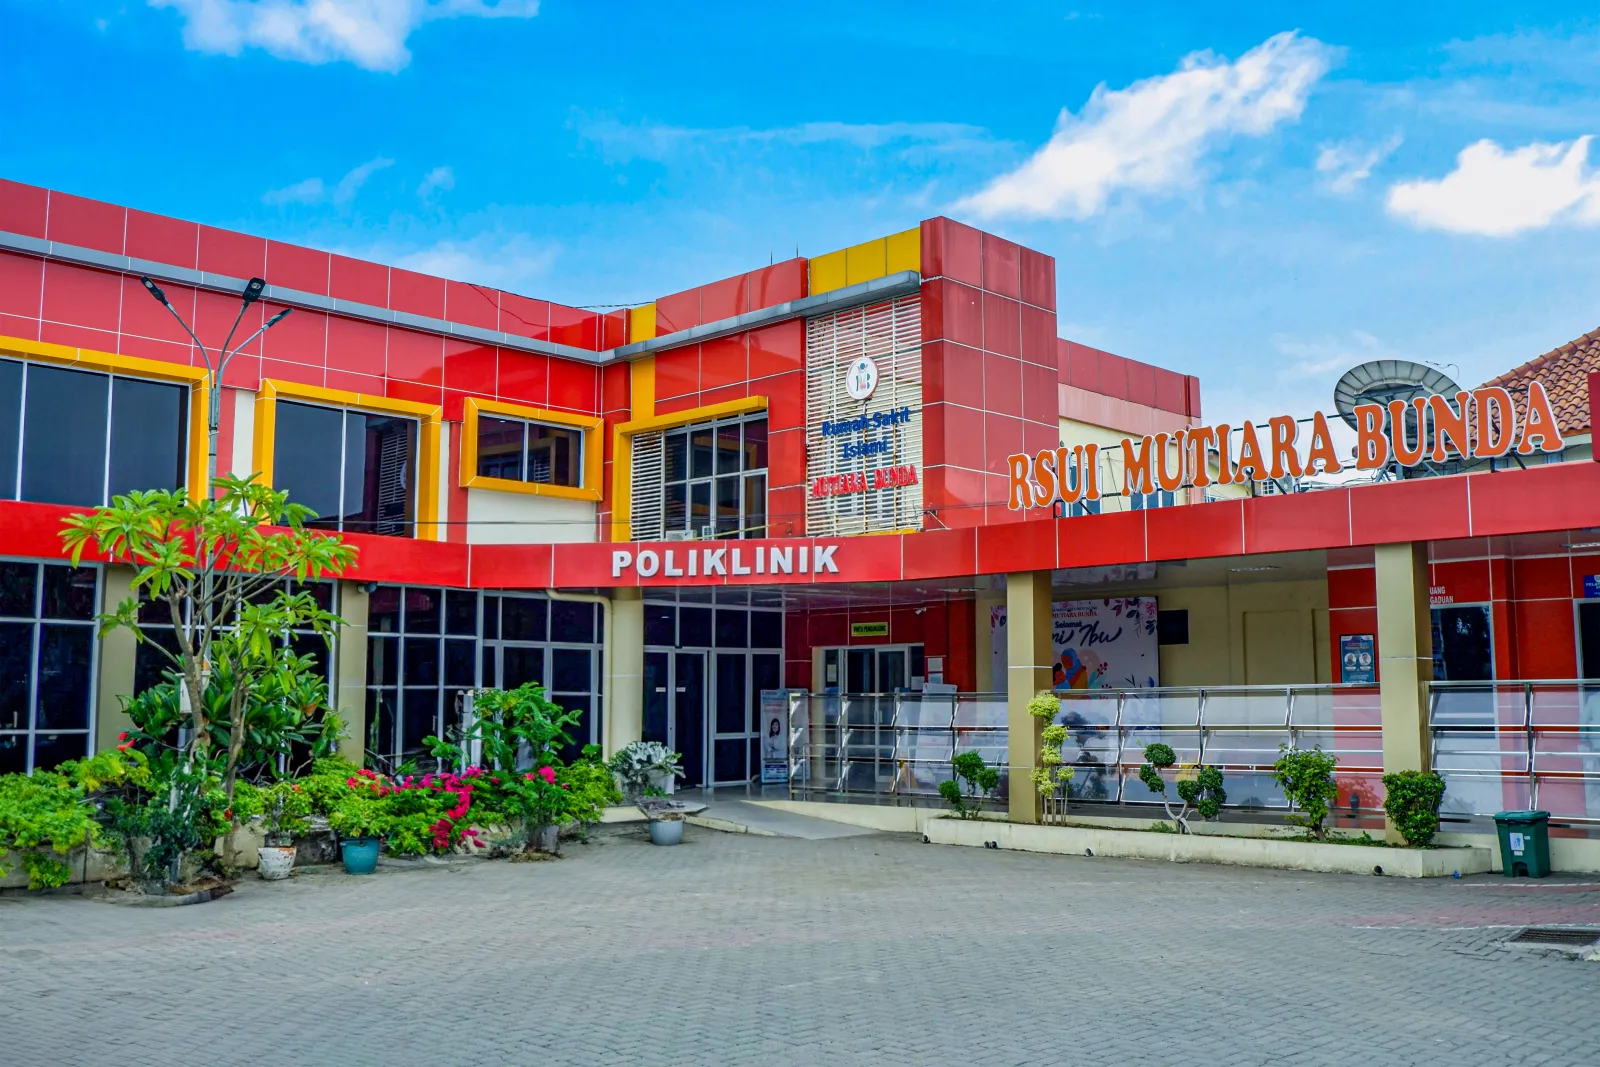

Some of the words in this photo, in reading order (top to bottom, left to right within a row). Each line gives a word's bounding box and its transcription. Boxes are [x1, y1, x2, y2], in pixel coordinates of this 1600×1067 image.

[821, 415, 868, 437] Rumah
[872, 406, 911, 428] Sakit
[1007, 443, 1101, 511] RSUI
[1120, 410, 1344, 498] MUTIARA
[1353, 380, 1566, 471] BUNDA
[812, 472, 868, 497] MUTIARA
[873, 464, 918, 490] BUNDA
[612, 545, 840, 578] POLIKLINIK
[1429, 586, 1446, 595] UANG
[1429, 595, 1454, 605] GADUAN
